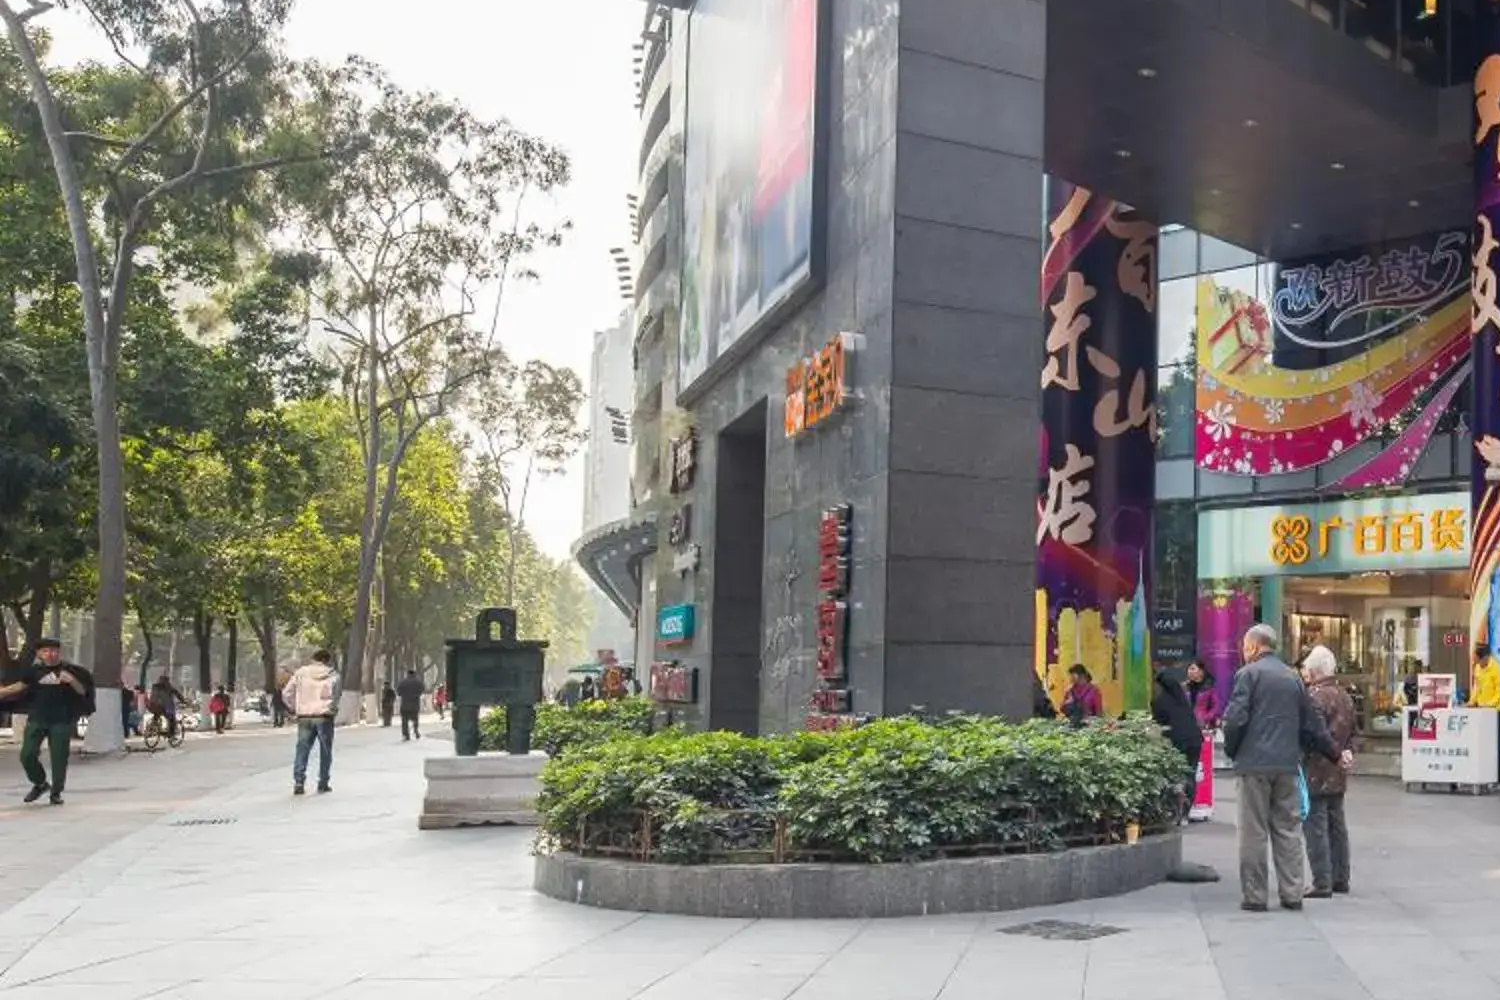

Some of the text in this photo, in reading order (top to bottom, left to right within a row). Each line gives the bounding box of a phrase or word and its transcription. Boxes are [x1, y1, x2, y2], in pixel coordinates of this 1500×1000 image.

[1318, 508, 1466, 559] 广百百货
[1447, 714, 1469, 731] EF
